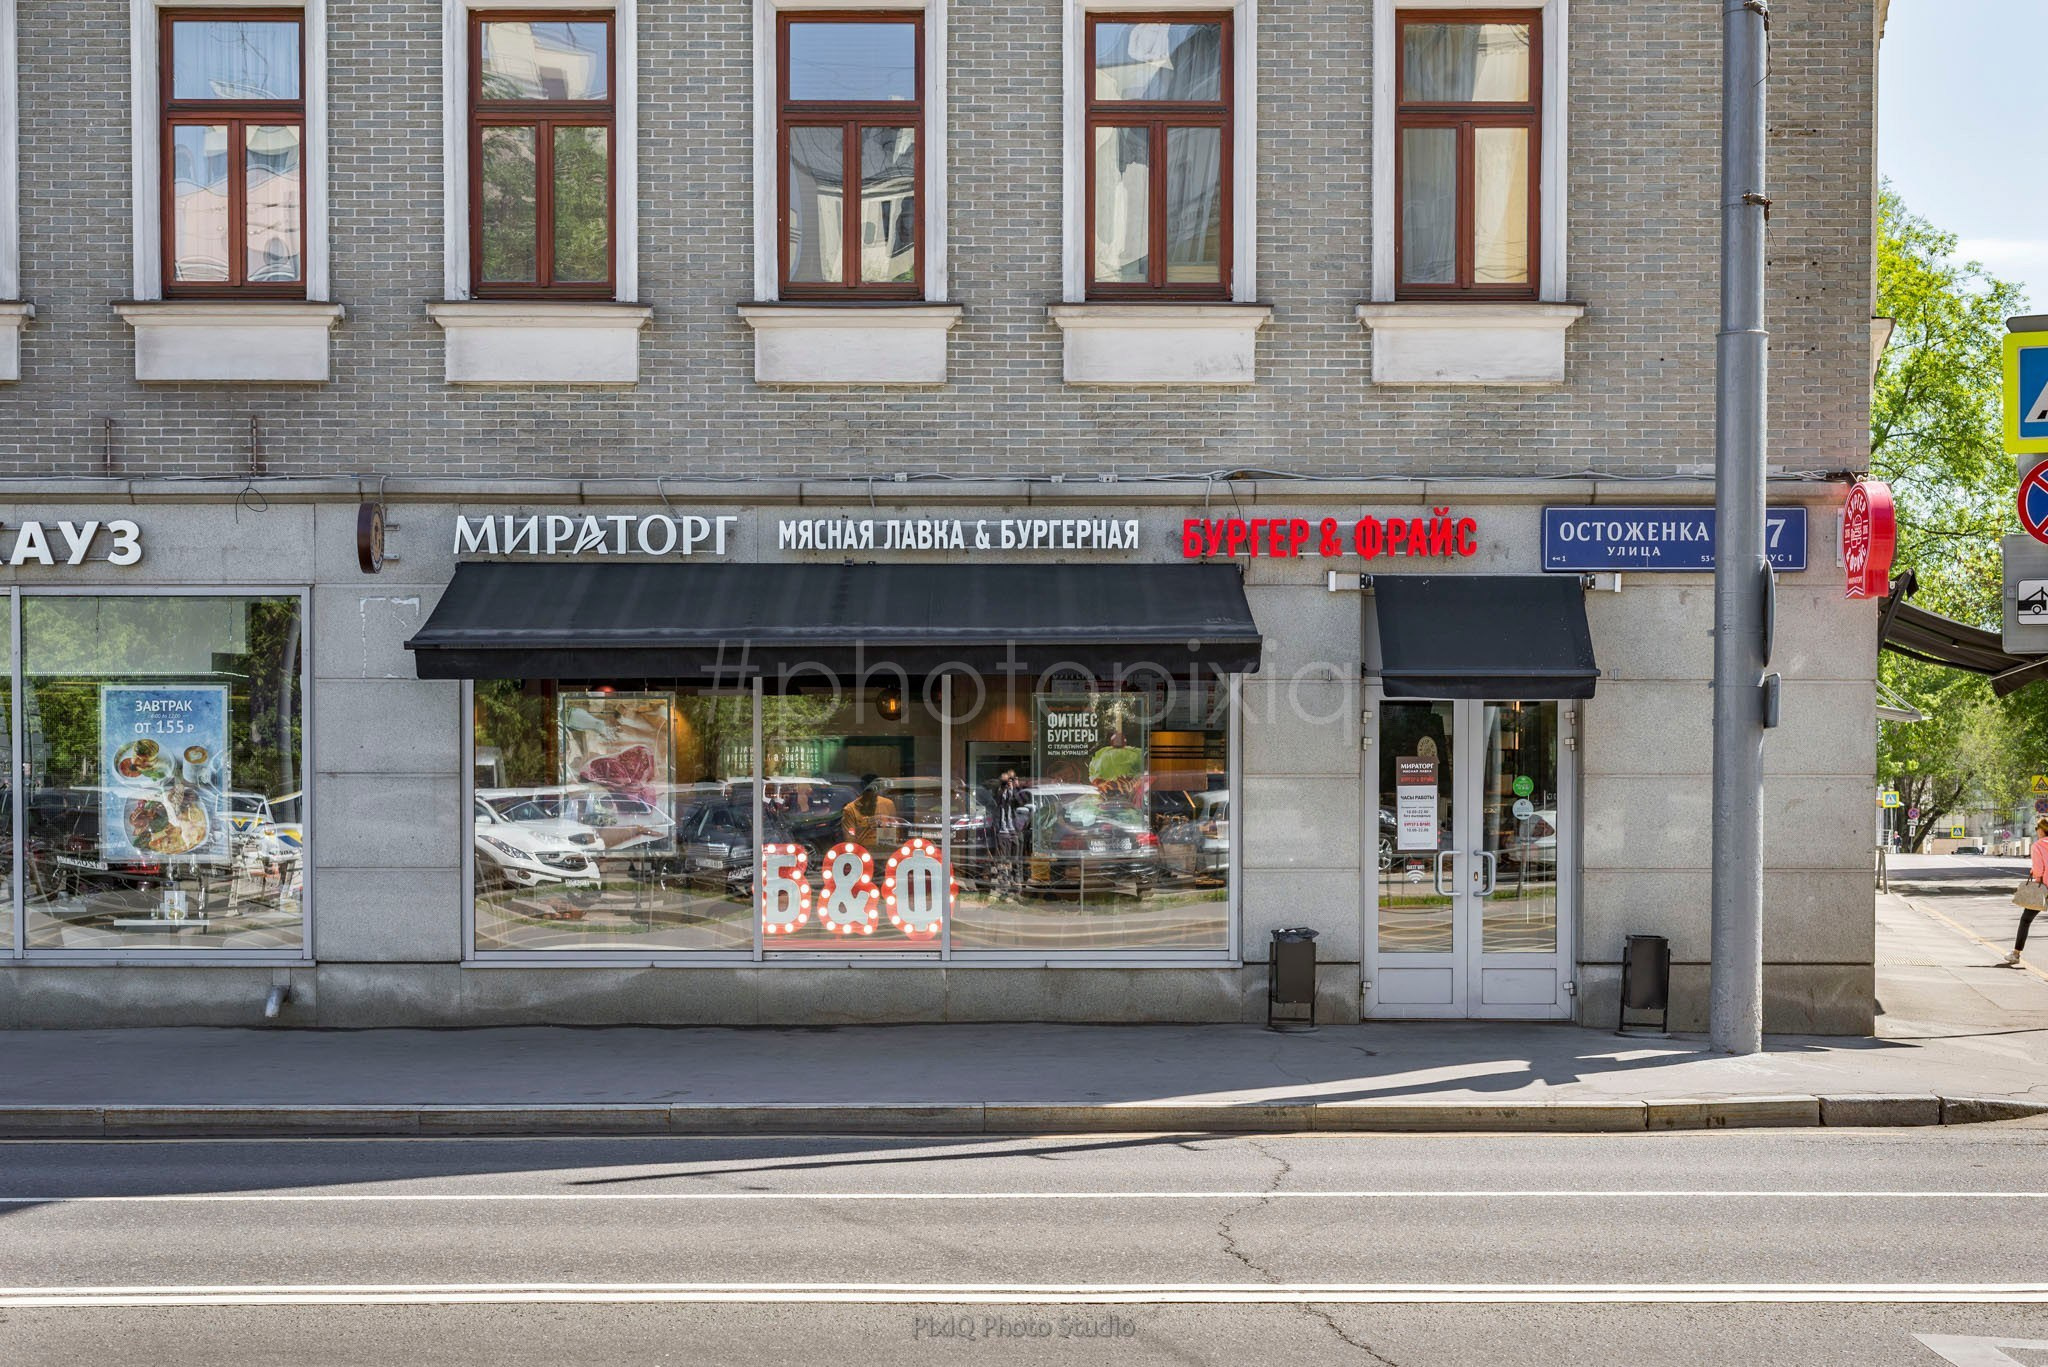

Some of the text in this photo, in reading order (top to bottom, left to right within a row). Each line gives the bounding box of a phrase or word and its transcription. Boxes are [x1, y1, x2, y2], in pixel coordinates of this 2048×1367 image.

[453, 514, 738, 555] МИРАТОРГ
[778, 519, 1139, 550] МЯСНАЯ ЛАВКА & БУРГЕРНАЯ
[1182, 507, 1477, 560] БУРГЕР & ФРАЙС
[1559, 521, 1710, 542] ОСТОЖЕНКА
[0, 520, 142, 566] АУЗ
[1607, 546, 1661, 557] УЛИЦА
[135, 700, 193, 712] ЗАВТРАК
[134, 722, 152, 734] ОТ
[156, 720, 184, 734] 155
[1047, 712, 1098, 729] ФИТНЕС
[1047, 729, 1099, 743] БУРГЕРЫ
